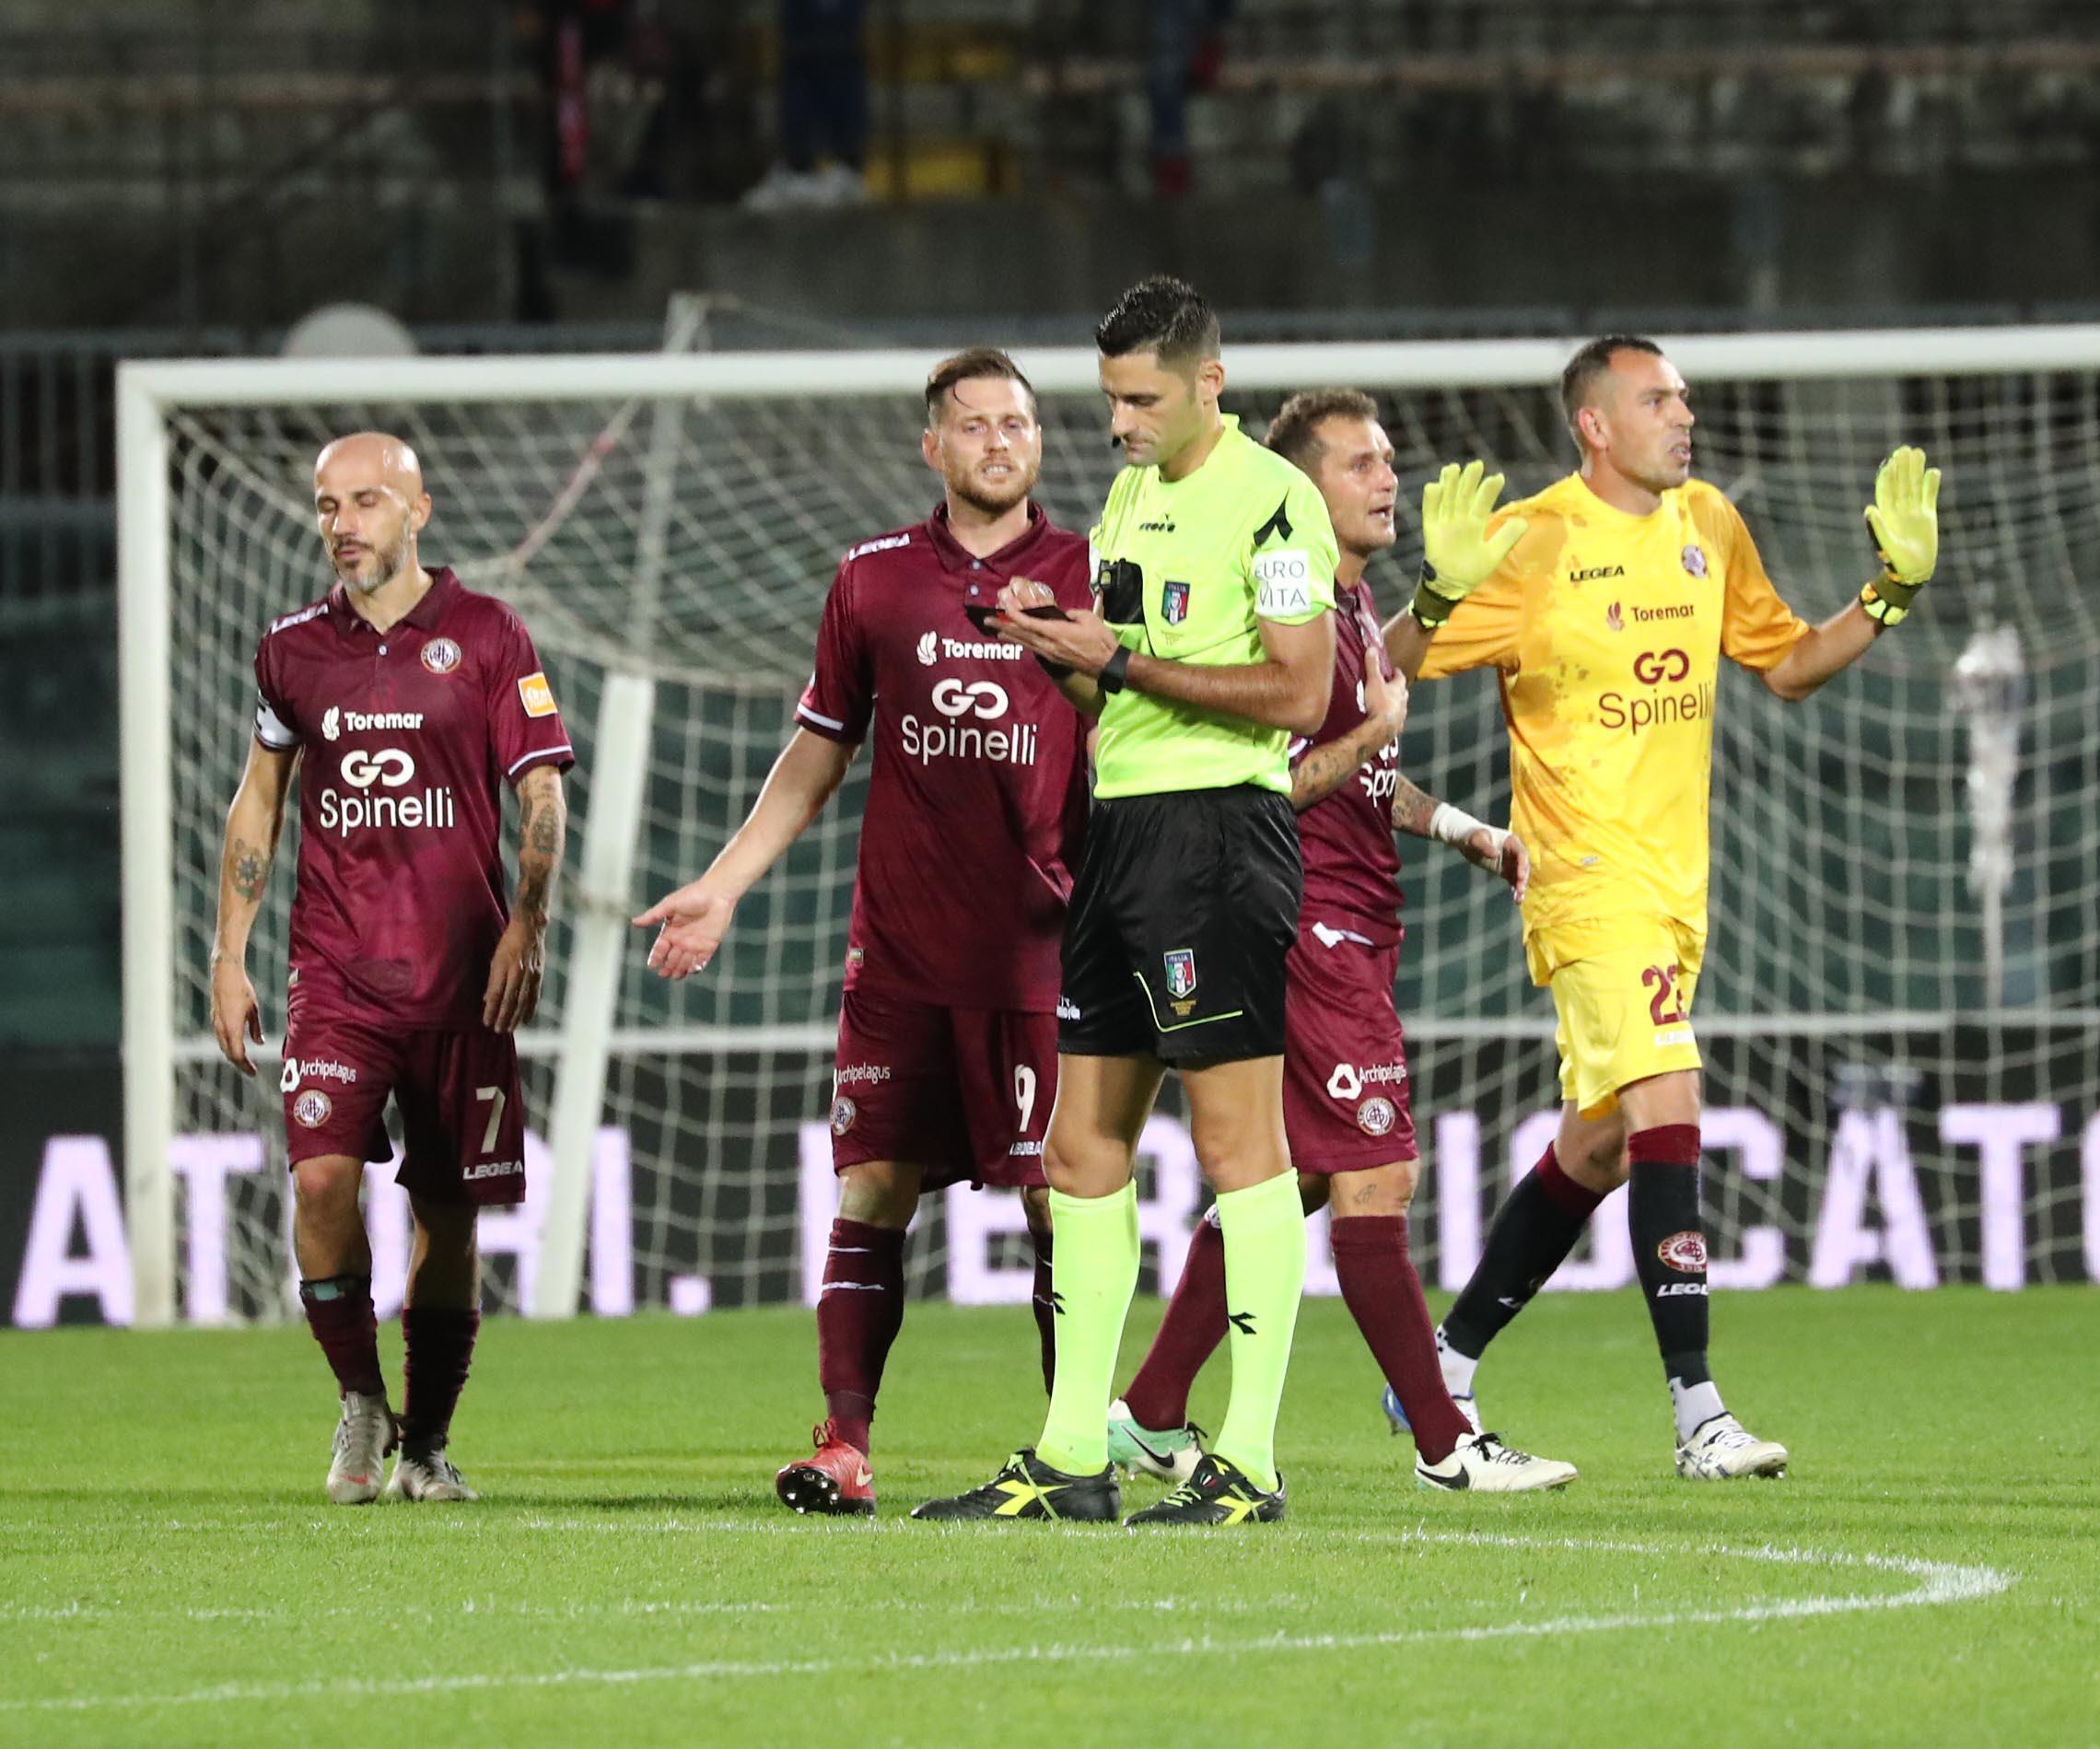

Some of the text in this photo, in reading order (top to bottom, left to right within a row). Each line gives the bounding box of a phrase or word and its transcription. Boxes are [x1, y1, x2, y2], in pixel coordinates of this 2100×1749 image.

[1254, 560, 1305, 581] EURO
[1569, 566, 1625, 582] LEGEA
[1259, 589, 1307, 608] VITA
[1630, 604, 1695, 622] Toremar
[941, 637, 1024, 660] Toremar
[1598, 682, 1712, 735] Spinelli
[344, 710, 424, 732] Toremar
[901, 715, 1038, 765] Spinelli
[320, 787, 455, 837] Spinelli
[299, 1059, 357, 1084] Archipelagus
[1014, 1064, 1036, 1133] 9
[475, 1086, 507, 1154] 7
[462, 1160, 524, 1181] LEGEA
